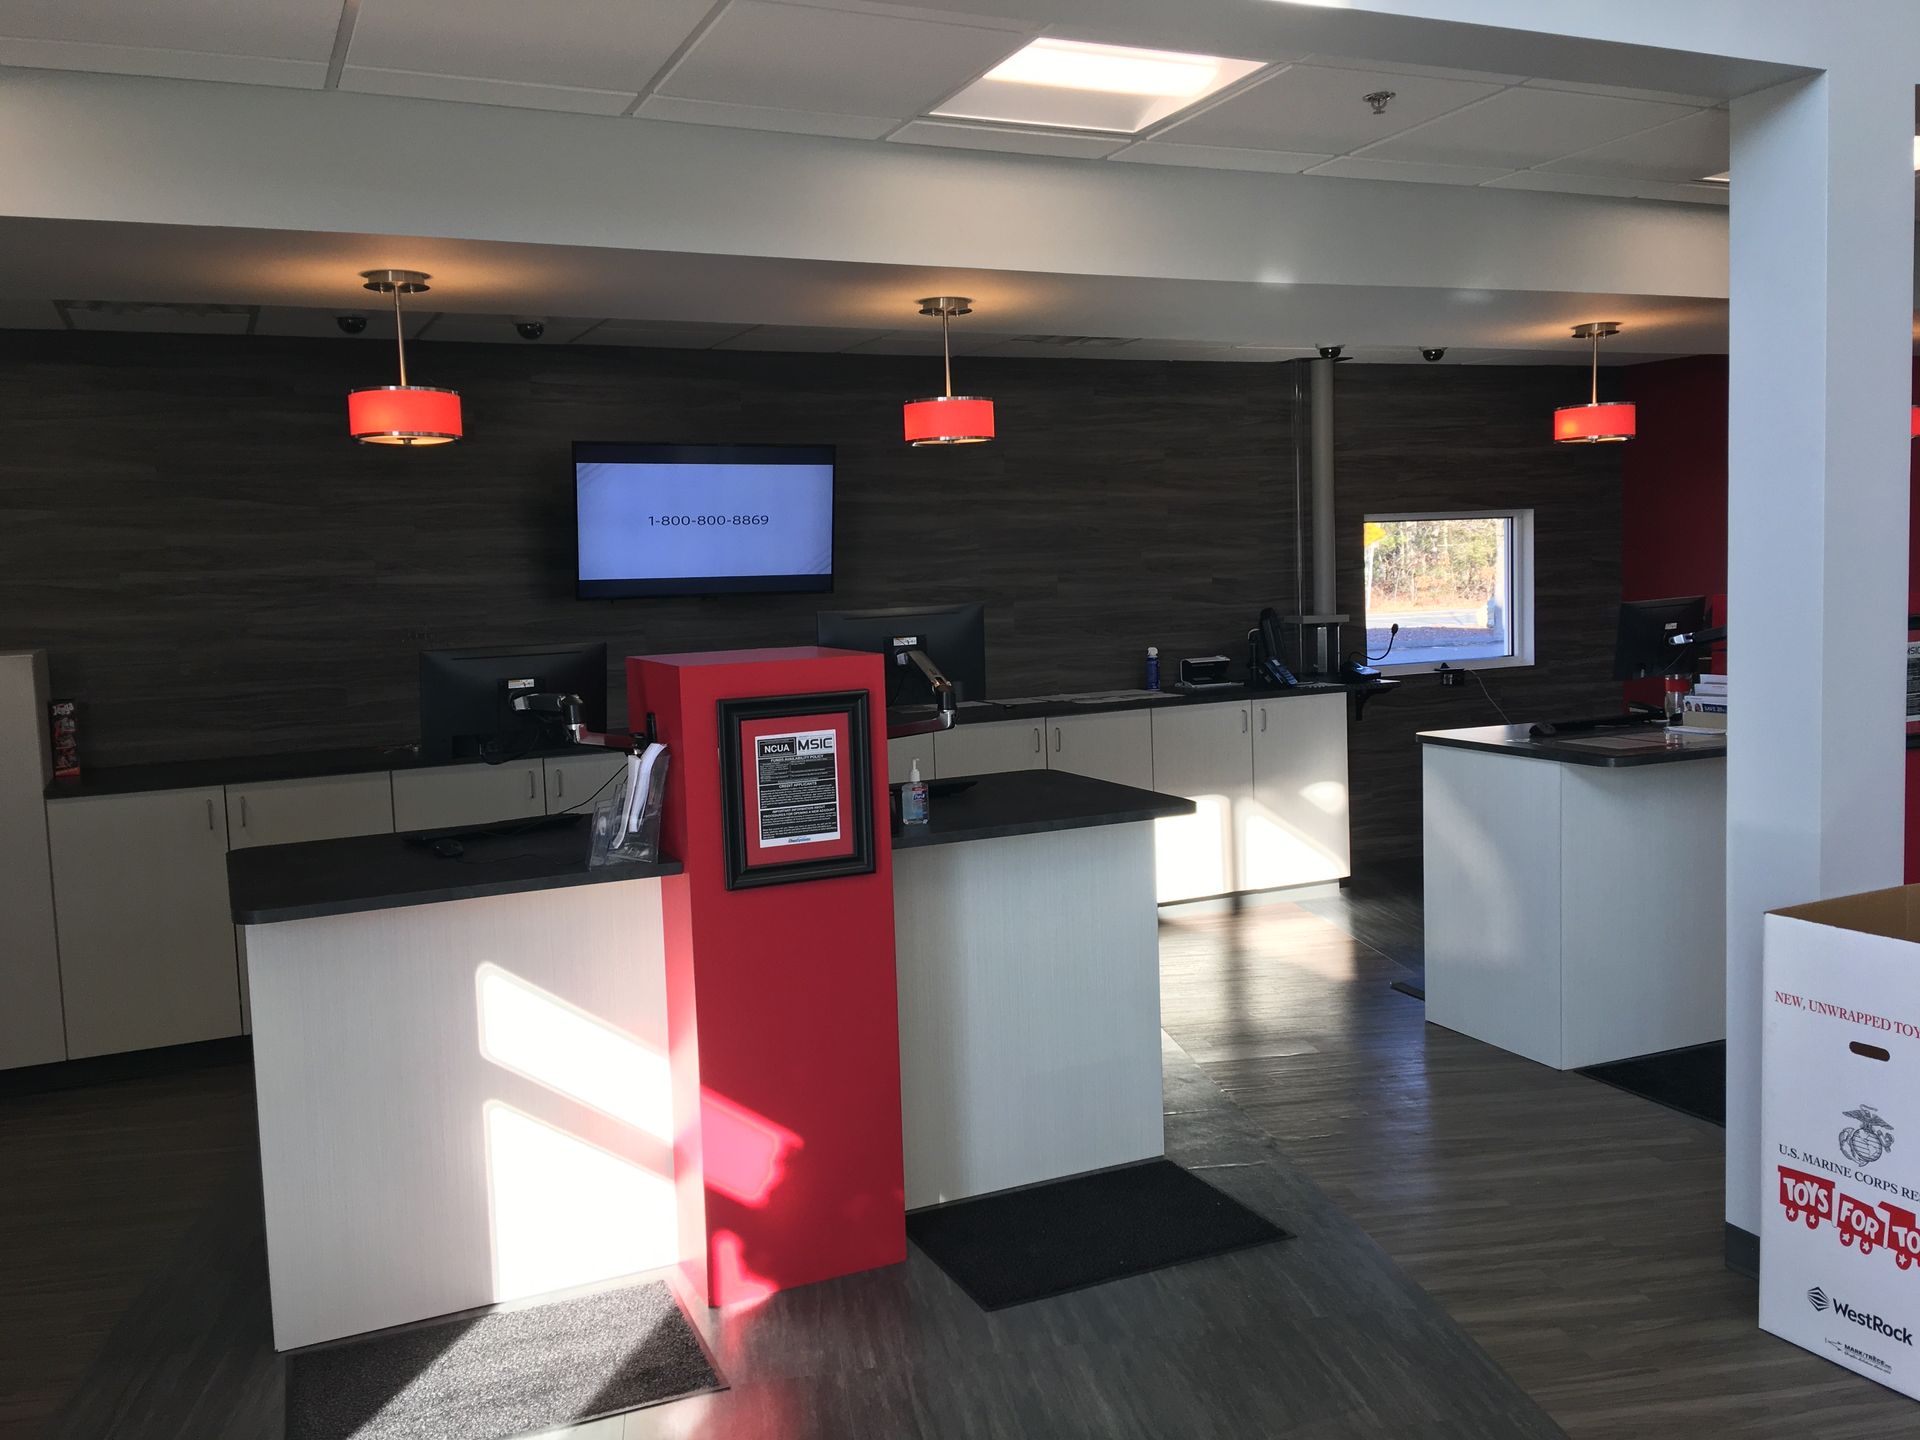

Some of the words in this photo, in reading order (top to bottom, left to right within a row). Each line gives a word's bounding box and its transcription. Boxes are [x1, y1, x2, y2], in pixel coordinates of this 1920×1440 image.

[648, 514, 770, 526] 1-800-800-8869
[764, 743, 790, 754] NCUA
[1774, 991, 1807, 1011] NEW,
[1808, 999, 1892, 1031] UNWRAPPED
[1778, 1143, 1800, 1160] U.S.
[1802, 1153, 1852, 1179] MARINE
[1854, 1170, 1898, 1195] CORPS
[1901, 1187, 1920, 1204] RE
[1783, 1177, 1829, 1214] TOYS
[1839, 1200, 1880, 1240] FOR
[1892, 1225, 1920, 1254] TO
[1832, 1298, 1914, 1346] WestRock
